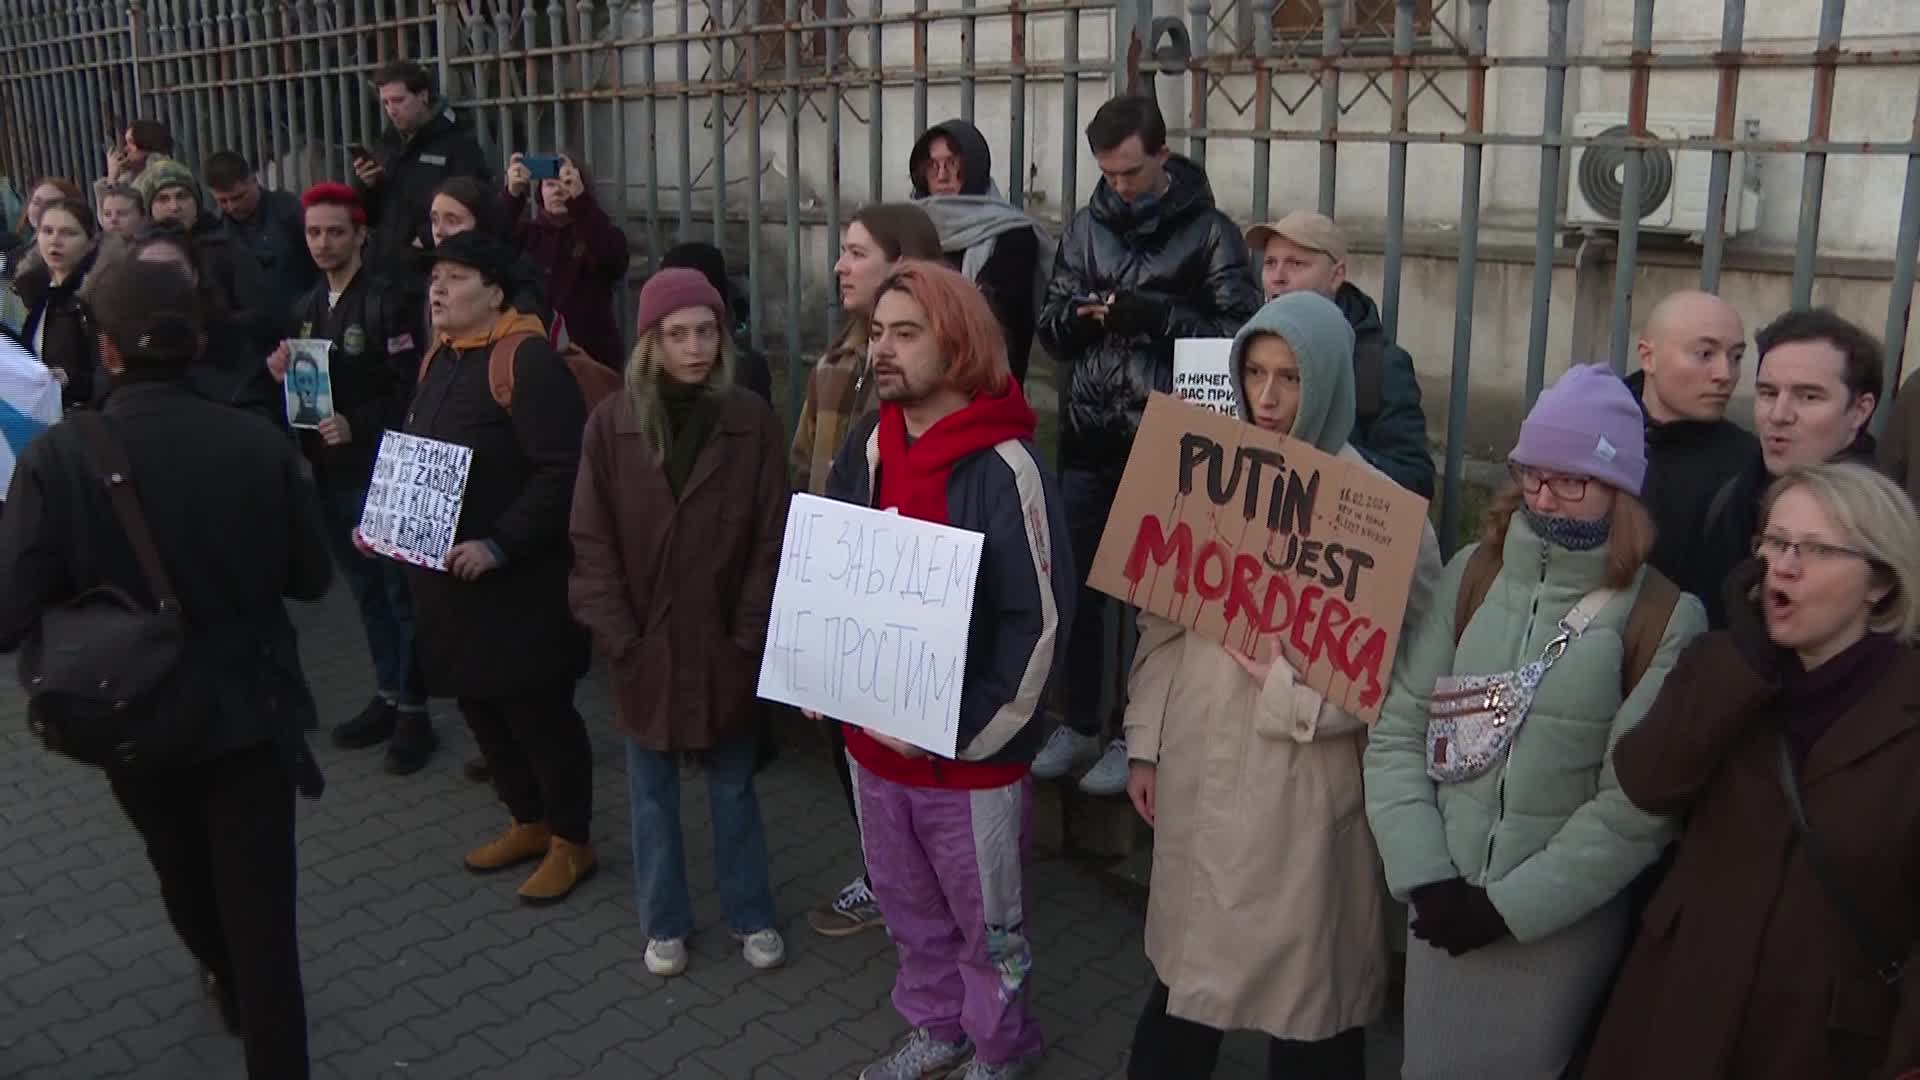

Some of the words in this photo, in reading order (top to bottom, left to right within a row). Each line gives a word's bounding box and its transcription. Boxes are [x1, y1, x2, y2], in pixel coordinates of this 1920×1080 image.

[1189, 373, 1232, 386] НИЧЕГ
[1208, 389, 1235, 402] ПРИ
[408, 489, 462, 525] KILLER
[785, 511, 824, 584] НЕ
[828, 520, 977, 610] ЗАБУДЕМ
[1262, 536, 1375, 602] JEST
[1123, 514, 1388, 709] MORDERCĄ
[769, 608, 812, 694] НЕ
[823, 615, 959, 734] ПРОСТИМ
